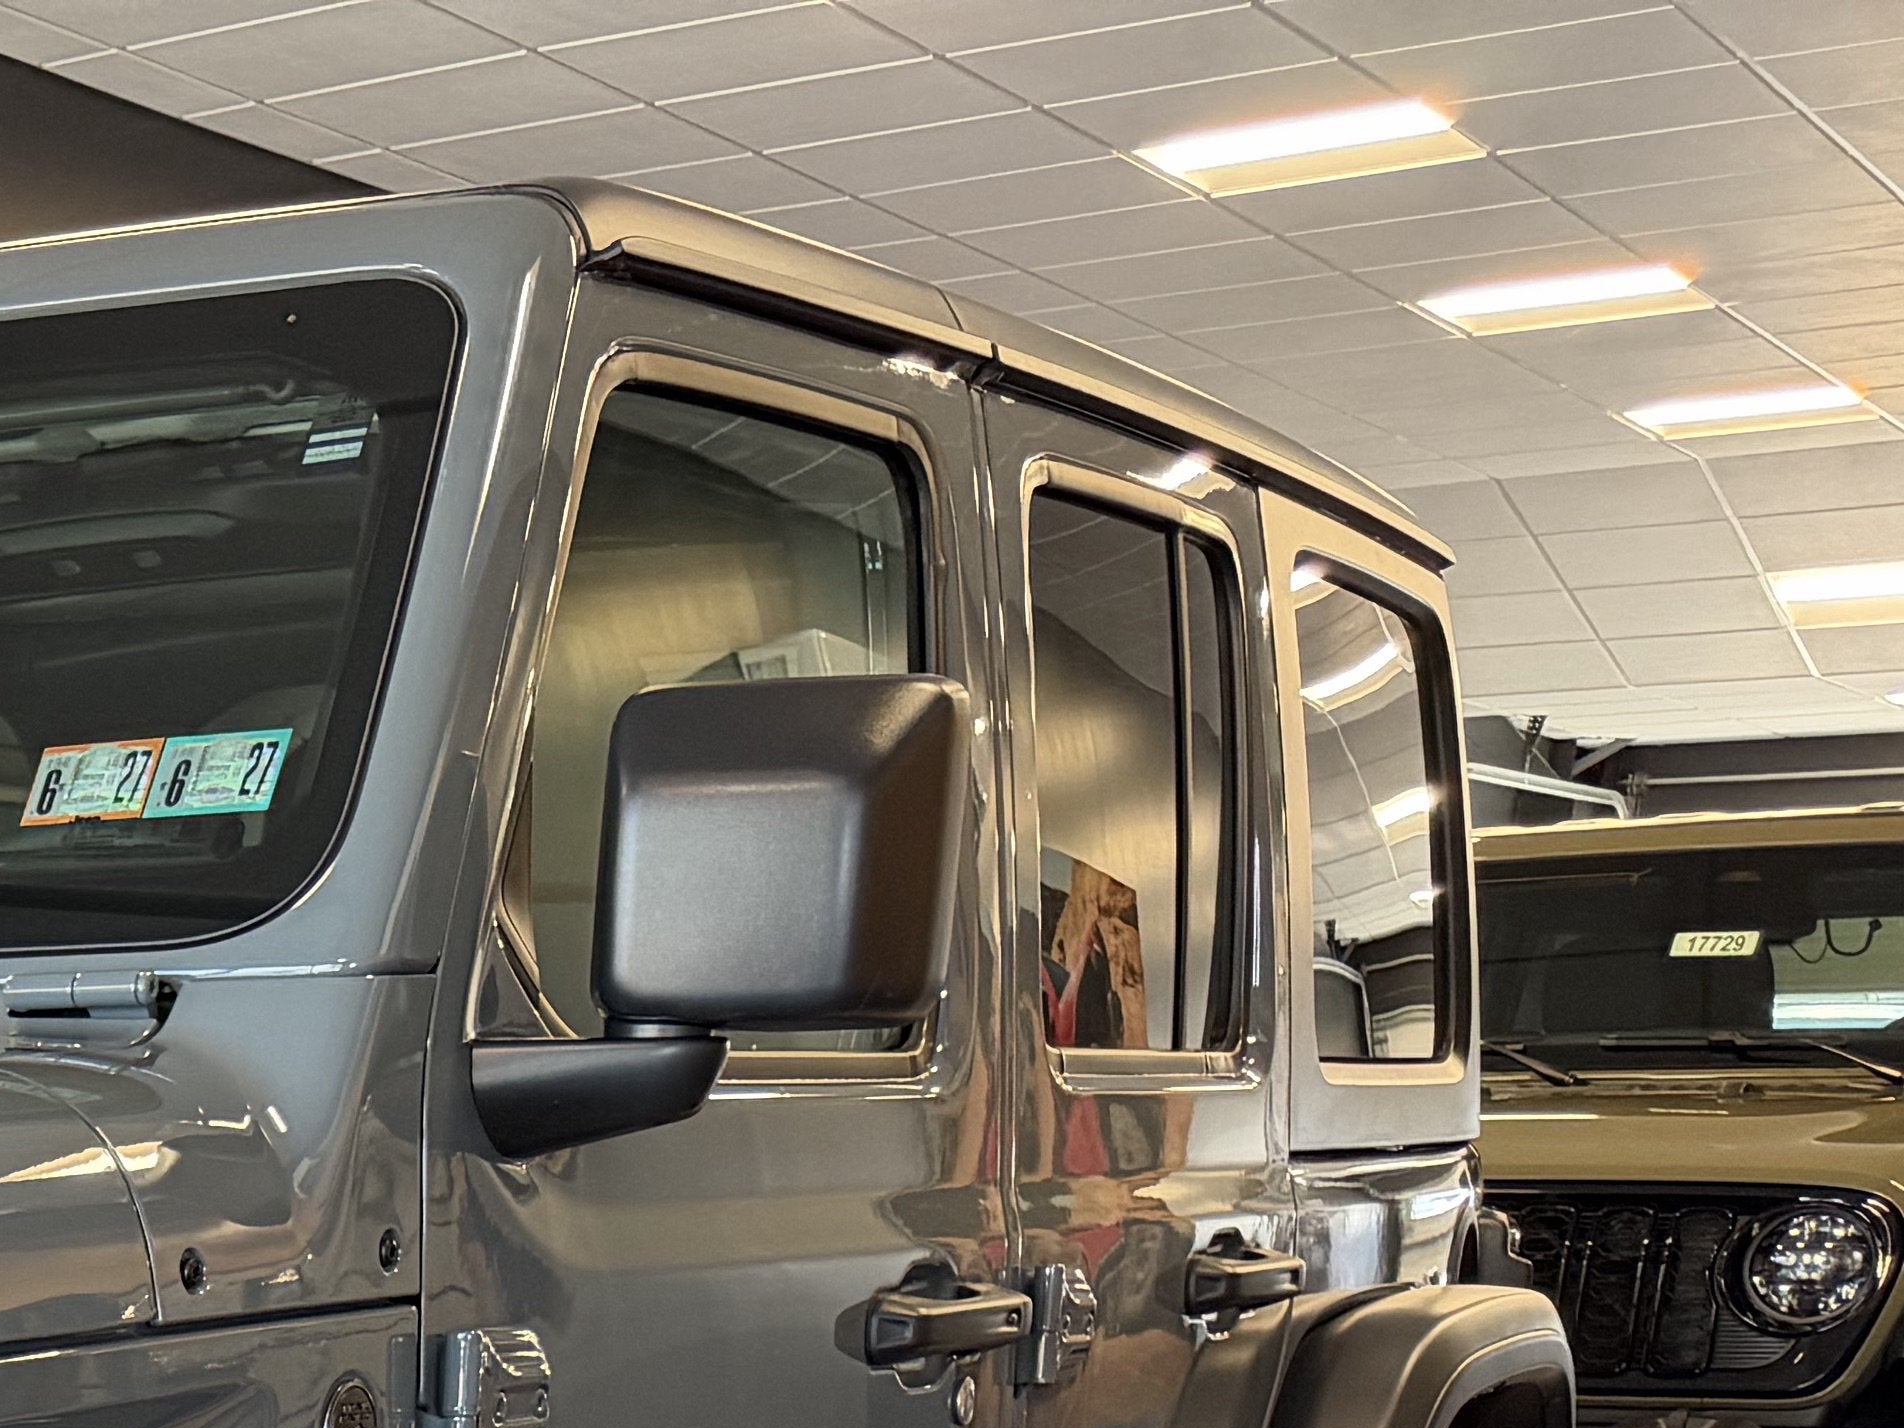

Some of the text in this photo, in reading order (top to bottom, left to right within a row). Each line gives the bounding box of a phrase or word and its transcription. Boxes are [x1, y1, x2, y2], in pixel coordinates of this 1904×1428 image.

[36, 750, 152, 816] 6 27
[165, 740, 280, 807] 6 27
[1688, 935, 1746, 952] 17729
